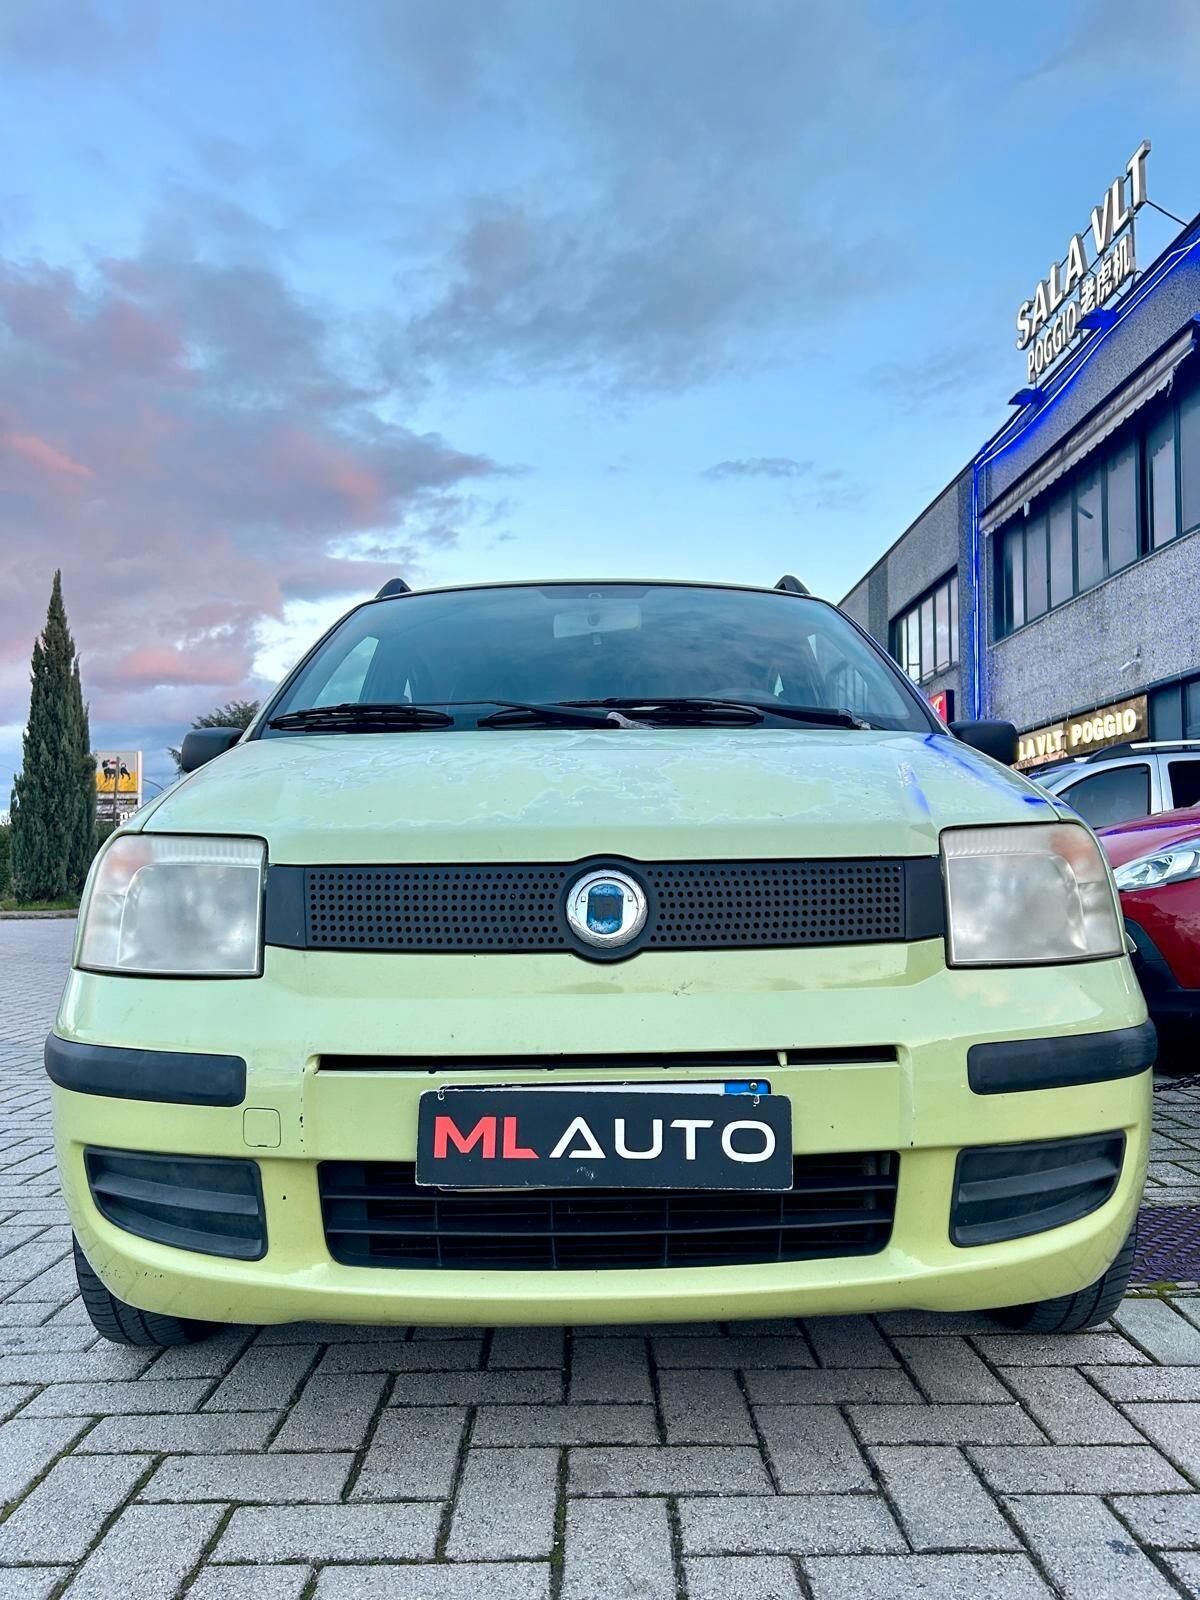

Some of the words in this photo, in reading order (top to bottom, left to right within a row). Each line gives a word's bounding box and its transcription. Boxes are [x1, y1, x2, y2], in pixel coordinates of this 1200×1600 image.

[1016, 233, 1087, 350] SALA
[1091, 139, 1150, 255] VLT
[1028, 302, 1080, 383] POGGIO
[1070, 708, 1137, 747] POGGIO
[434, 1116, 540, 1159] ML
[549, 1116, 776, 1163] AUTO
